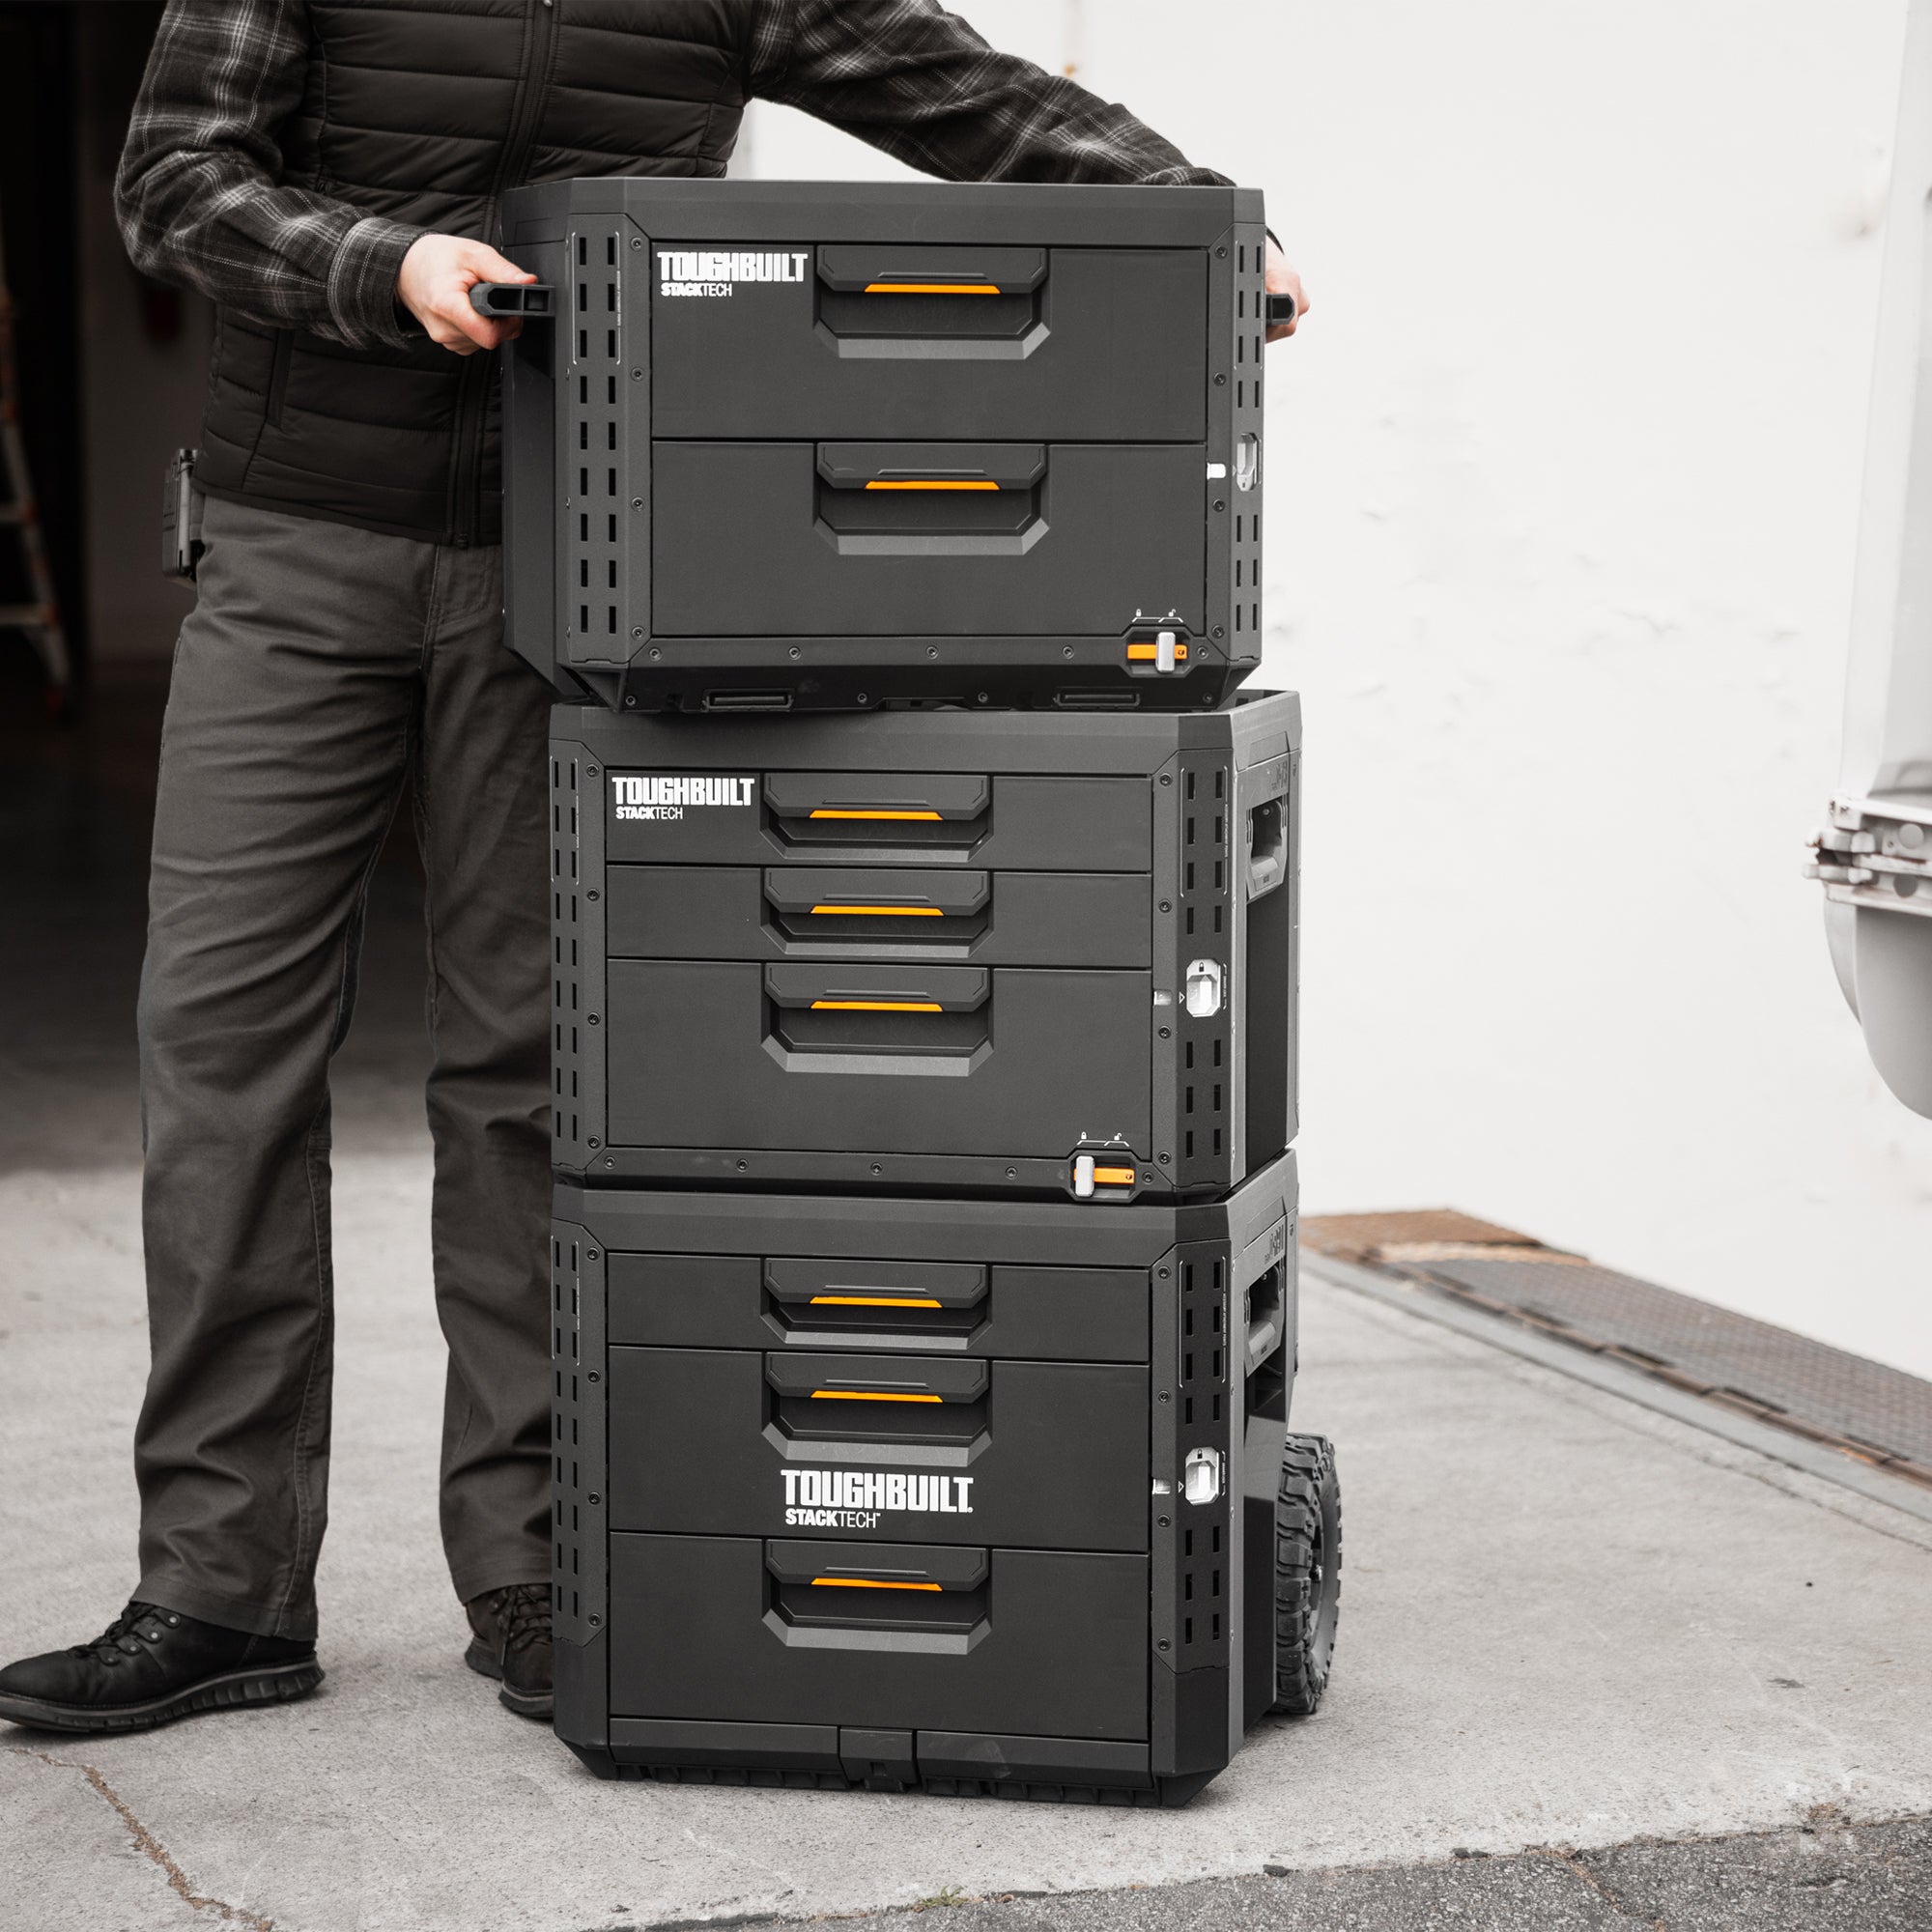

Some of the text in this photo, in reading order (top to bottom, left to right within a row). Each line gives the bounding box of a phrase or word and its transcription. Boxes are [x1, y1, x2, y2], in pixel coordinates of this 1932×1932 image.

[657, 251, 809, 282] TOUGHBUILT
[661, 282, 732, 297] STACKTECH
[611, 777, 755, 806] TOUGHBUILT
[615, 806, 683, 820] STACKTECH
